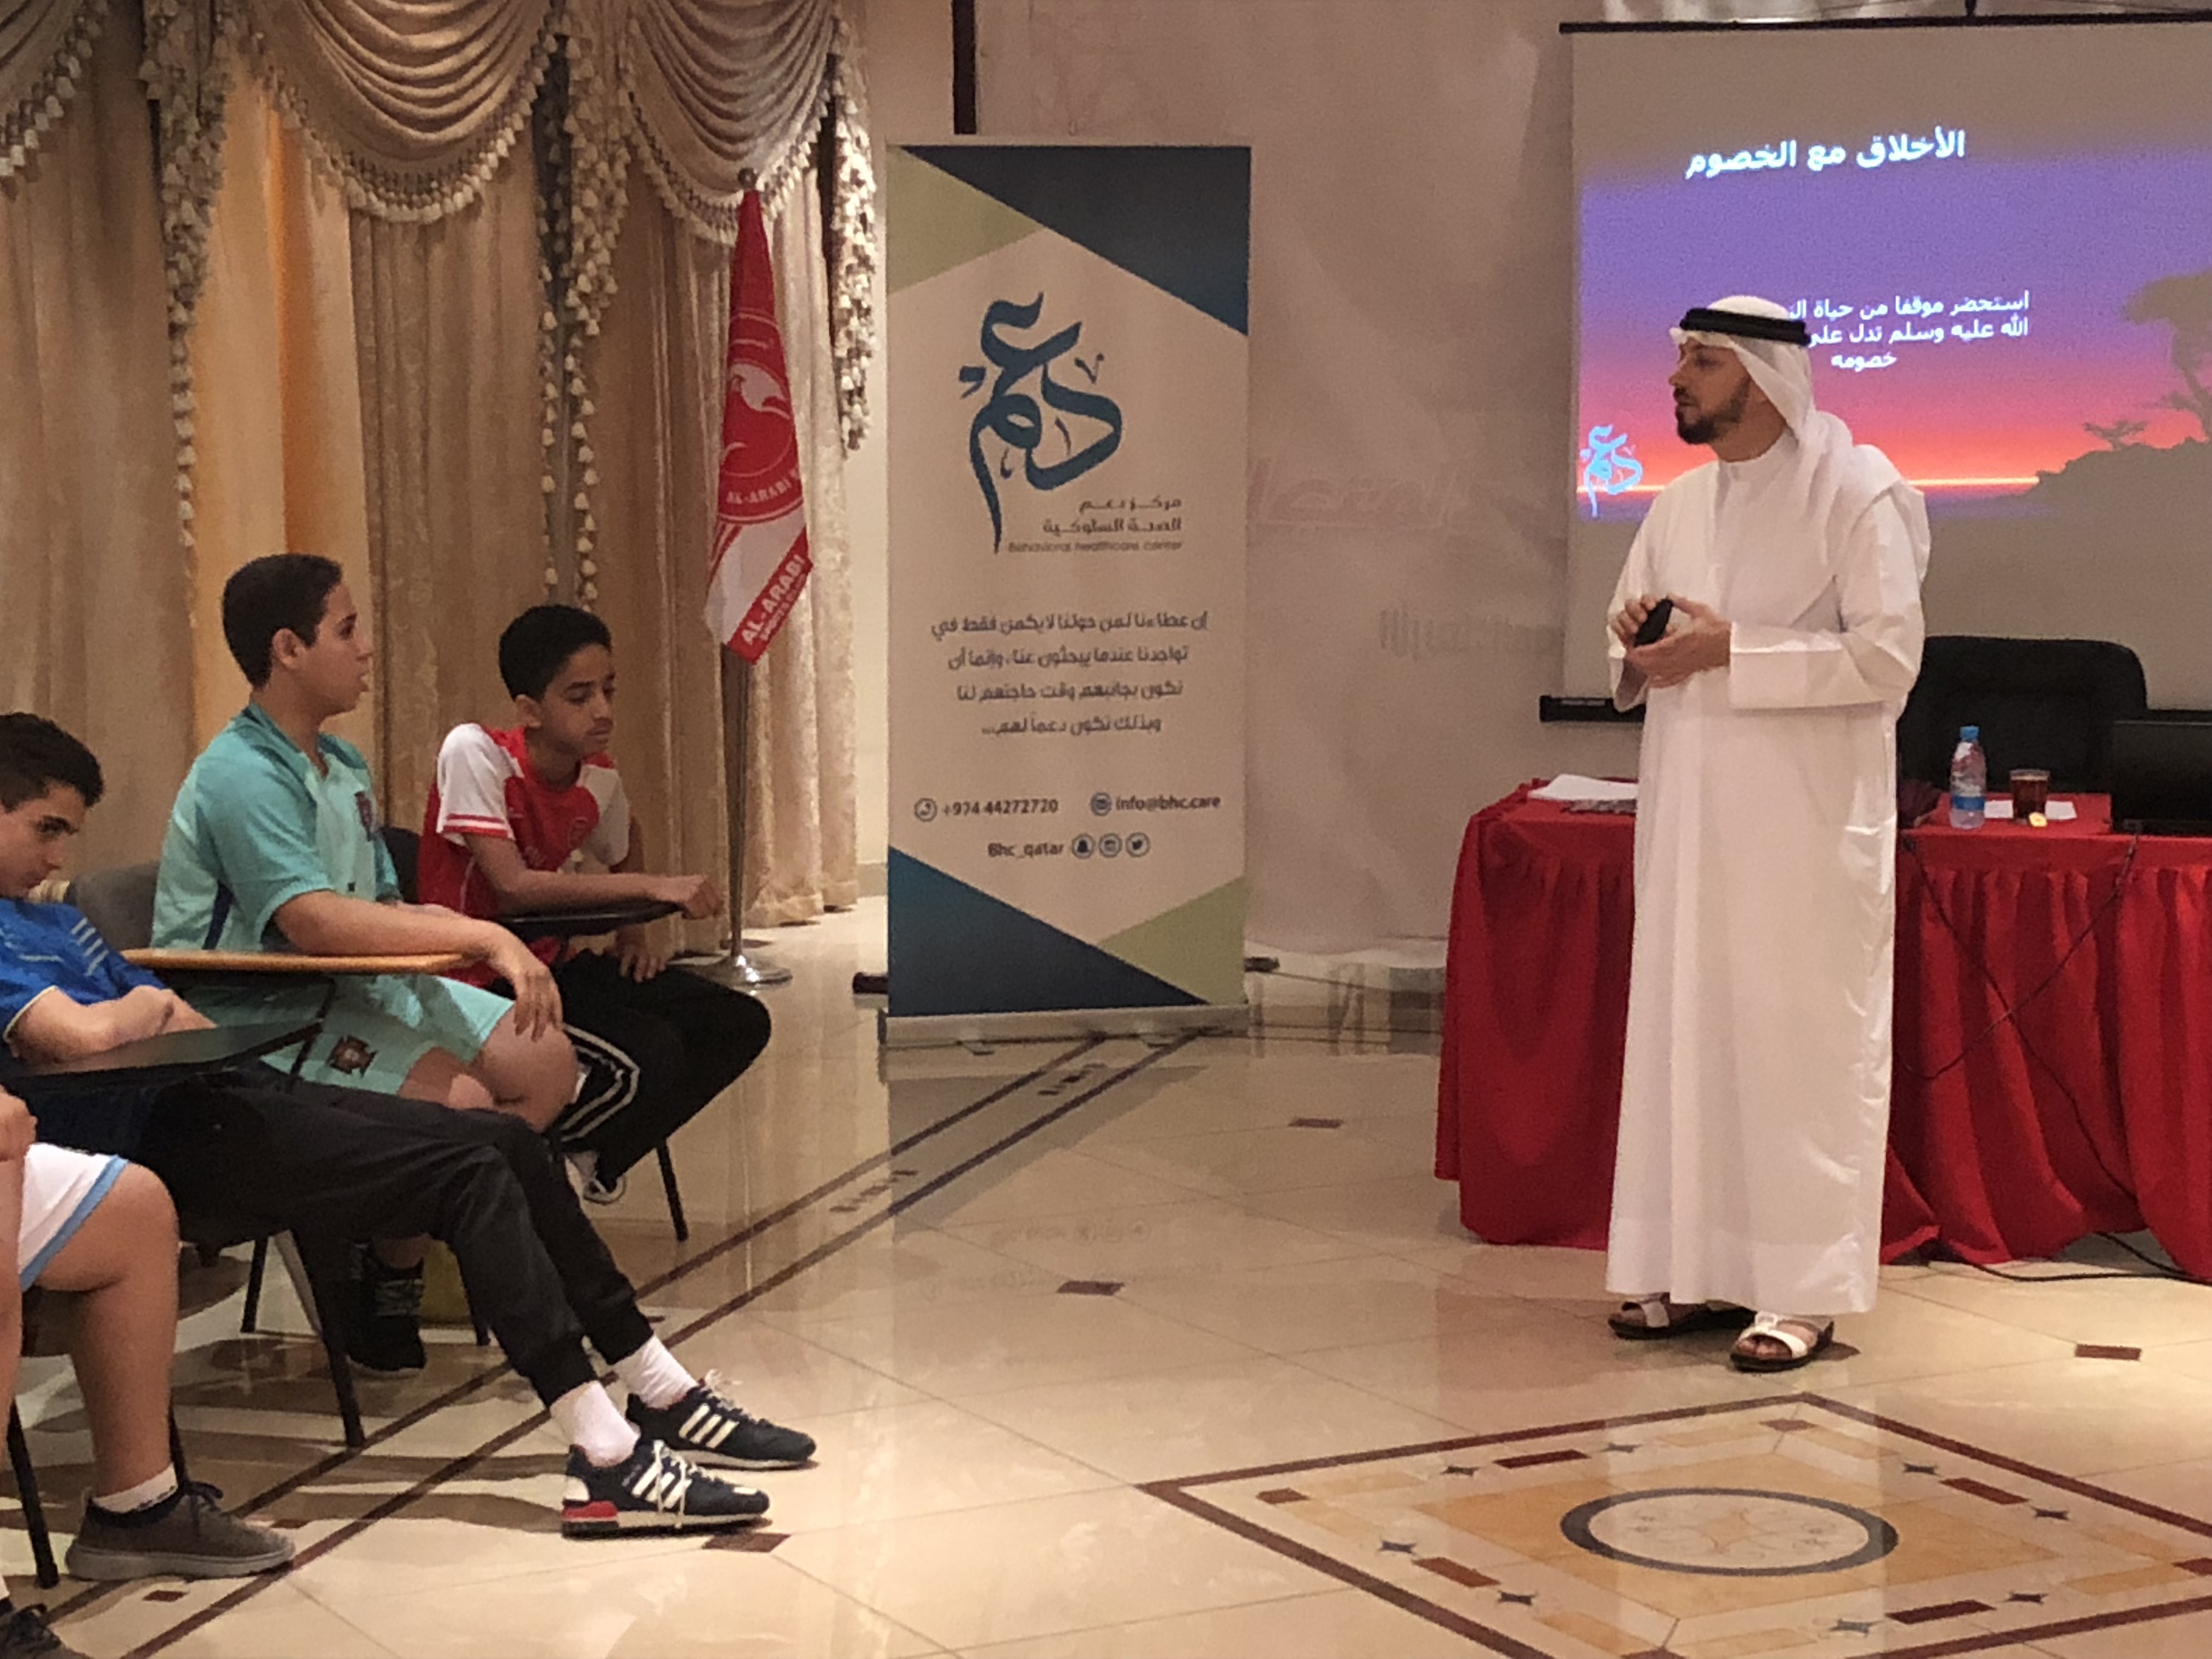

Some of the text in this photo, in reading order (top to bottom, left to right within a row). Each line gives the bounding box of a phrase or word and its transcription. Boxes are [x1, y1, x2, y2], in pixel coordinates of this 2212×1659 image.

[1684, 125, 1966, 180] الأخلاق مع الخصوم
[1813, 298, 1854, 321] حياة
[1859, 303, 1889, 320] من
[1895, 295, 1944, 318] موقفا
[1949, 290, 2029, 317] استحضر
[1849, 323, 1883, 343] تدل
[1888, 321, 1945, 344] وسلم
[1950, 318, 1995, 342] عليه
[2000, 313, 2028, 337] الله
[1831, 352, 1898, 373] خصومه
[1128, 495, 1181, 511] مركز
[1042, 517, 1181, 537] الصحة السلوكية
[741, 554, 805, 646] AL-ARABI
[931, 617, 958, 641] في
[962, 615, 997, 631] فقط
[1094, 647, 1134, 662] عندما
[1078, 682, 1138, 701] بجانبهم
[1141, 680, 1184, 700] نكون
[943, 801, 980, 816] +974
